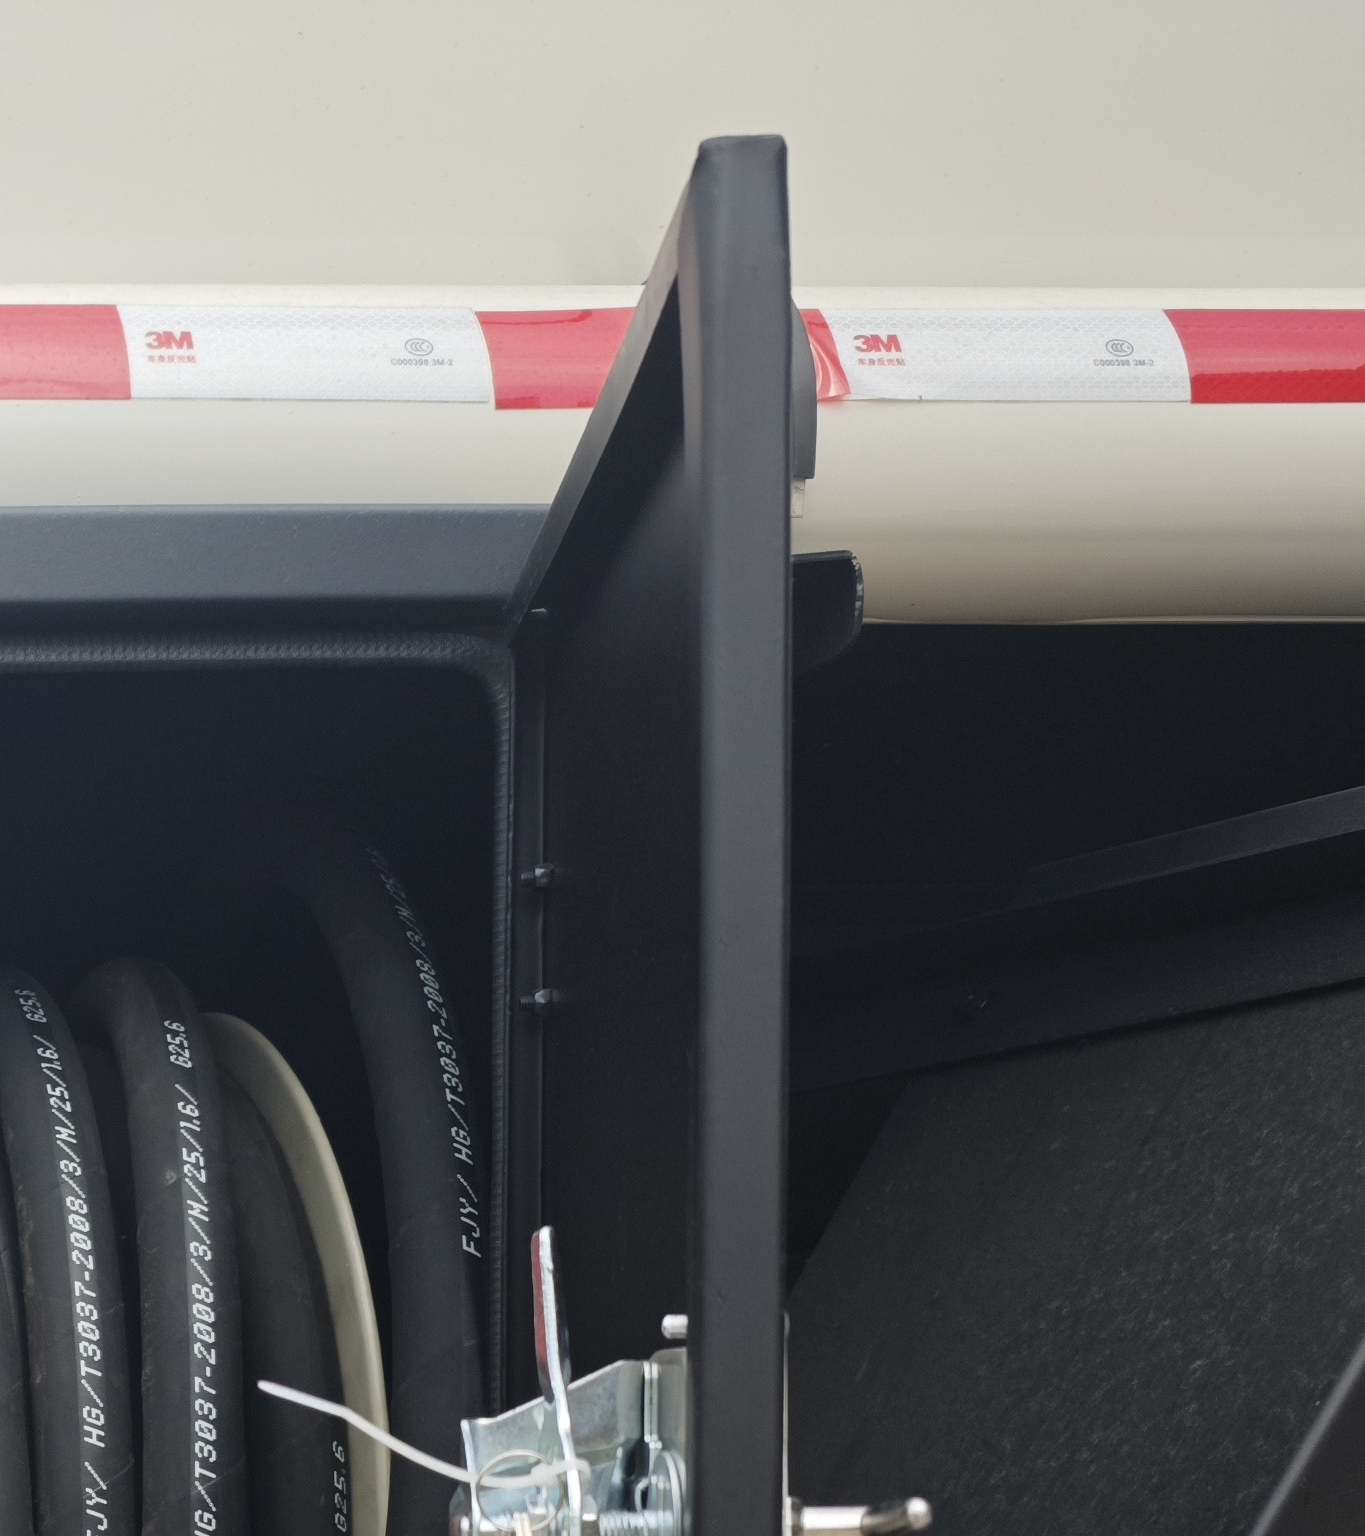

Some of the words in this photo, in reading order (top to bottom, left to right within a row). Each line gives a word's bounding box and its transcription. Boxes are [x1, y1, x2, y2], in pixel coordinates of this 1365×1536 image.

[144, 331, 194, 350] 3M
[853, 334, 903, 353] 3M
[390, 357, 429, 366] C000398
[1093, 358, 1131, 368] C000398
[457, 1174, 482, 1257] FJY/
[33, 1035, 107, 1449] HG/T3037-2008/3/M/25/1.6/
